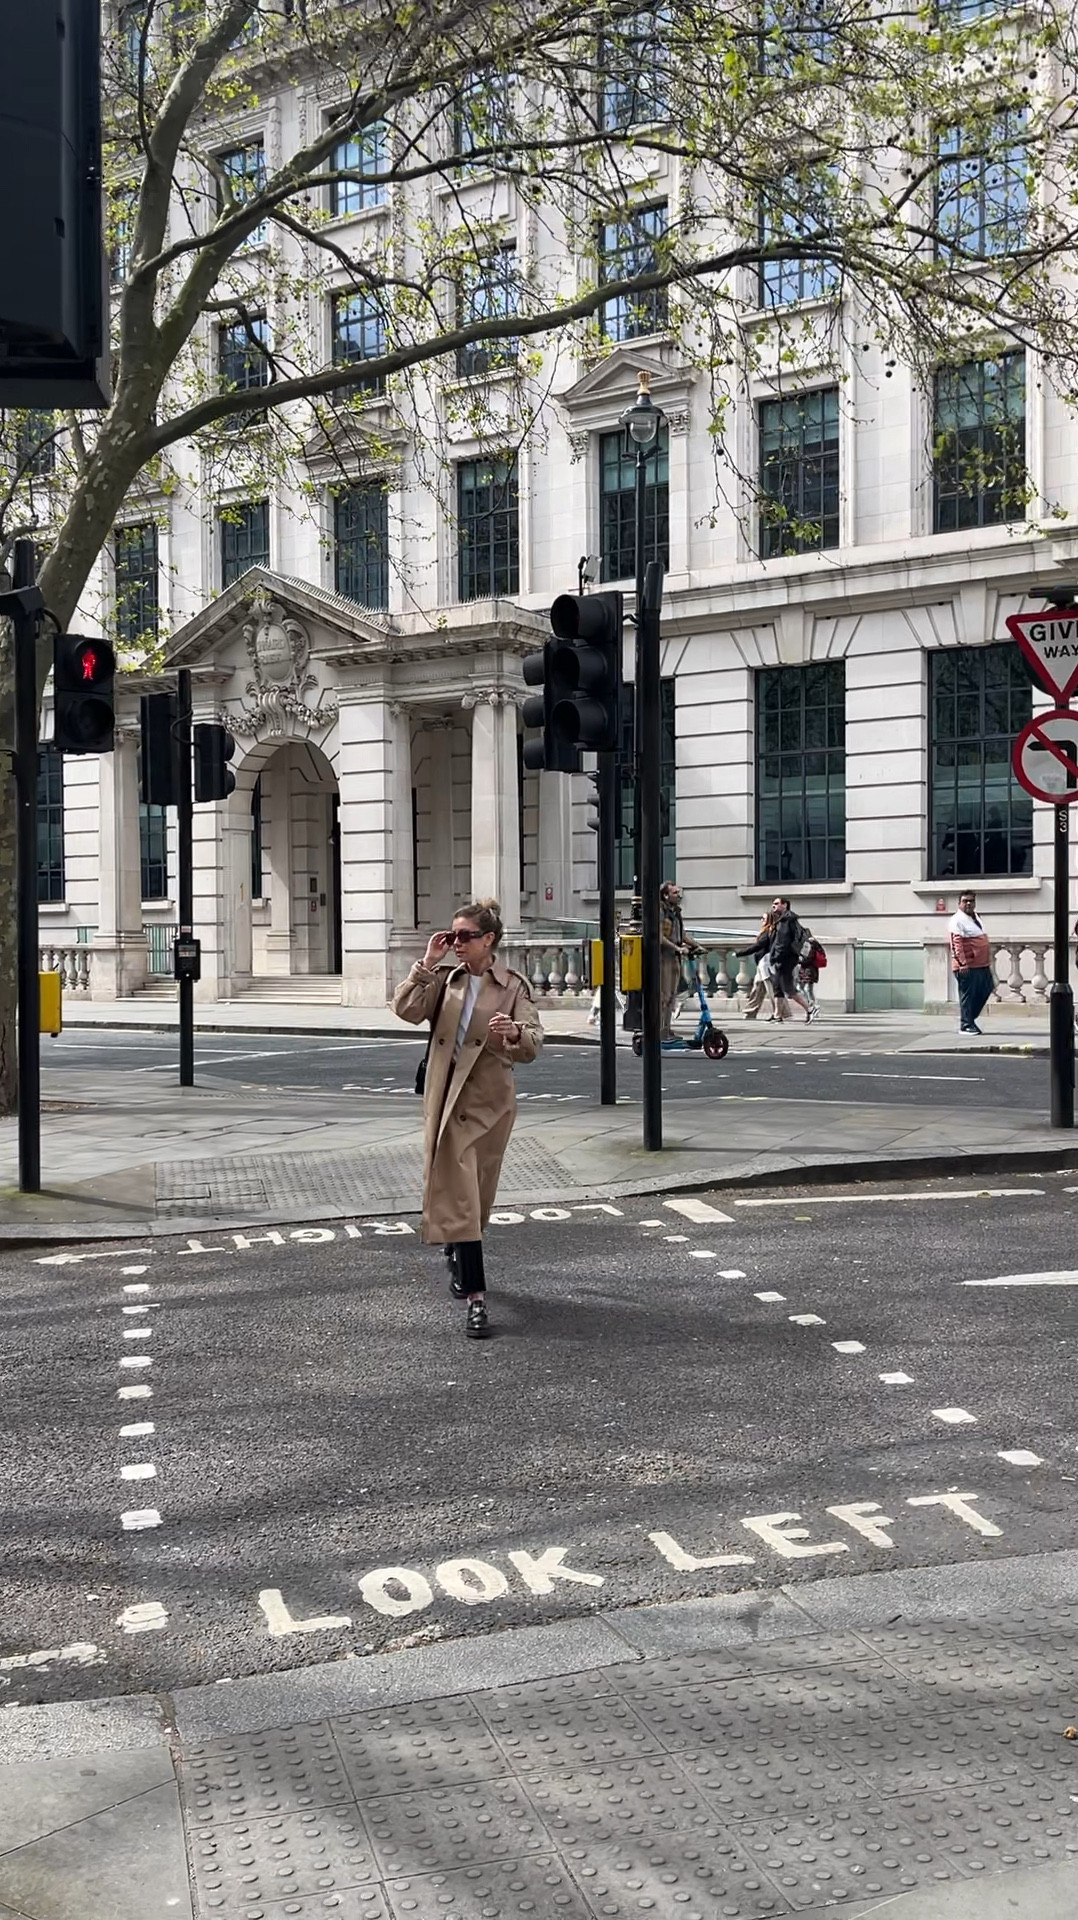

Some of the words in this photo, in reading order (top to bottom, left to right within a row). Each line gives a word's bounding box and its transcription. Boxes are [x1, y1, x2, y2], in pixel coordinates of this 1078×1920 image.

[488, 1203, 625, 1225] LOO
[176, 1221, 416, 1255] RIGHT
[257, 1547, 603, 1636] LOOK
[647, 1489, 1002, 1572] LEFT
